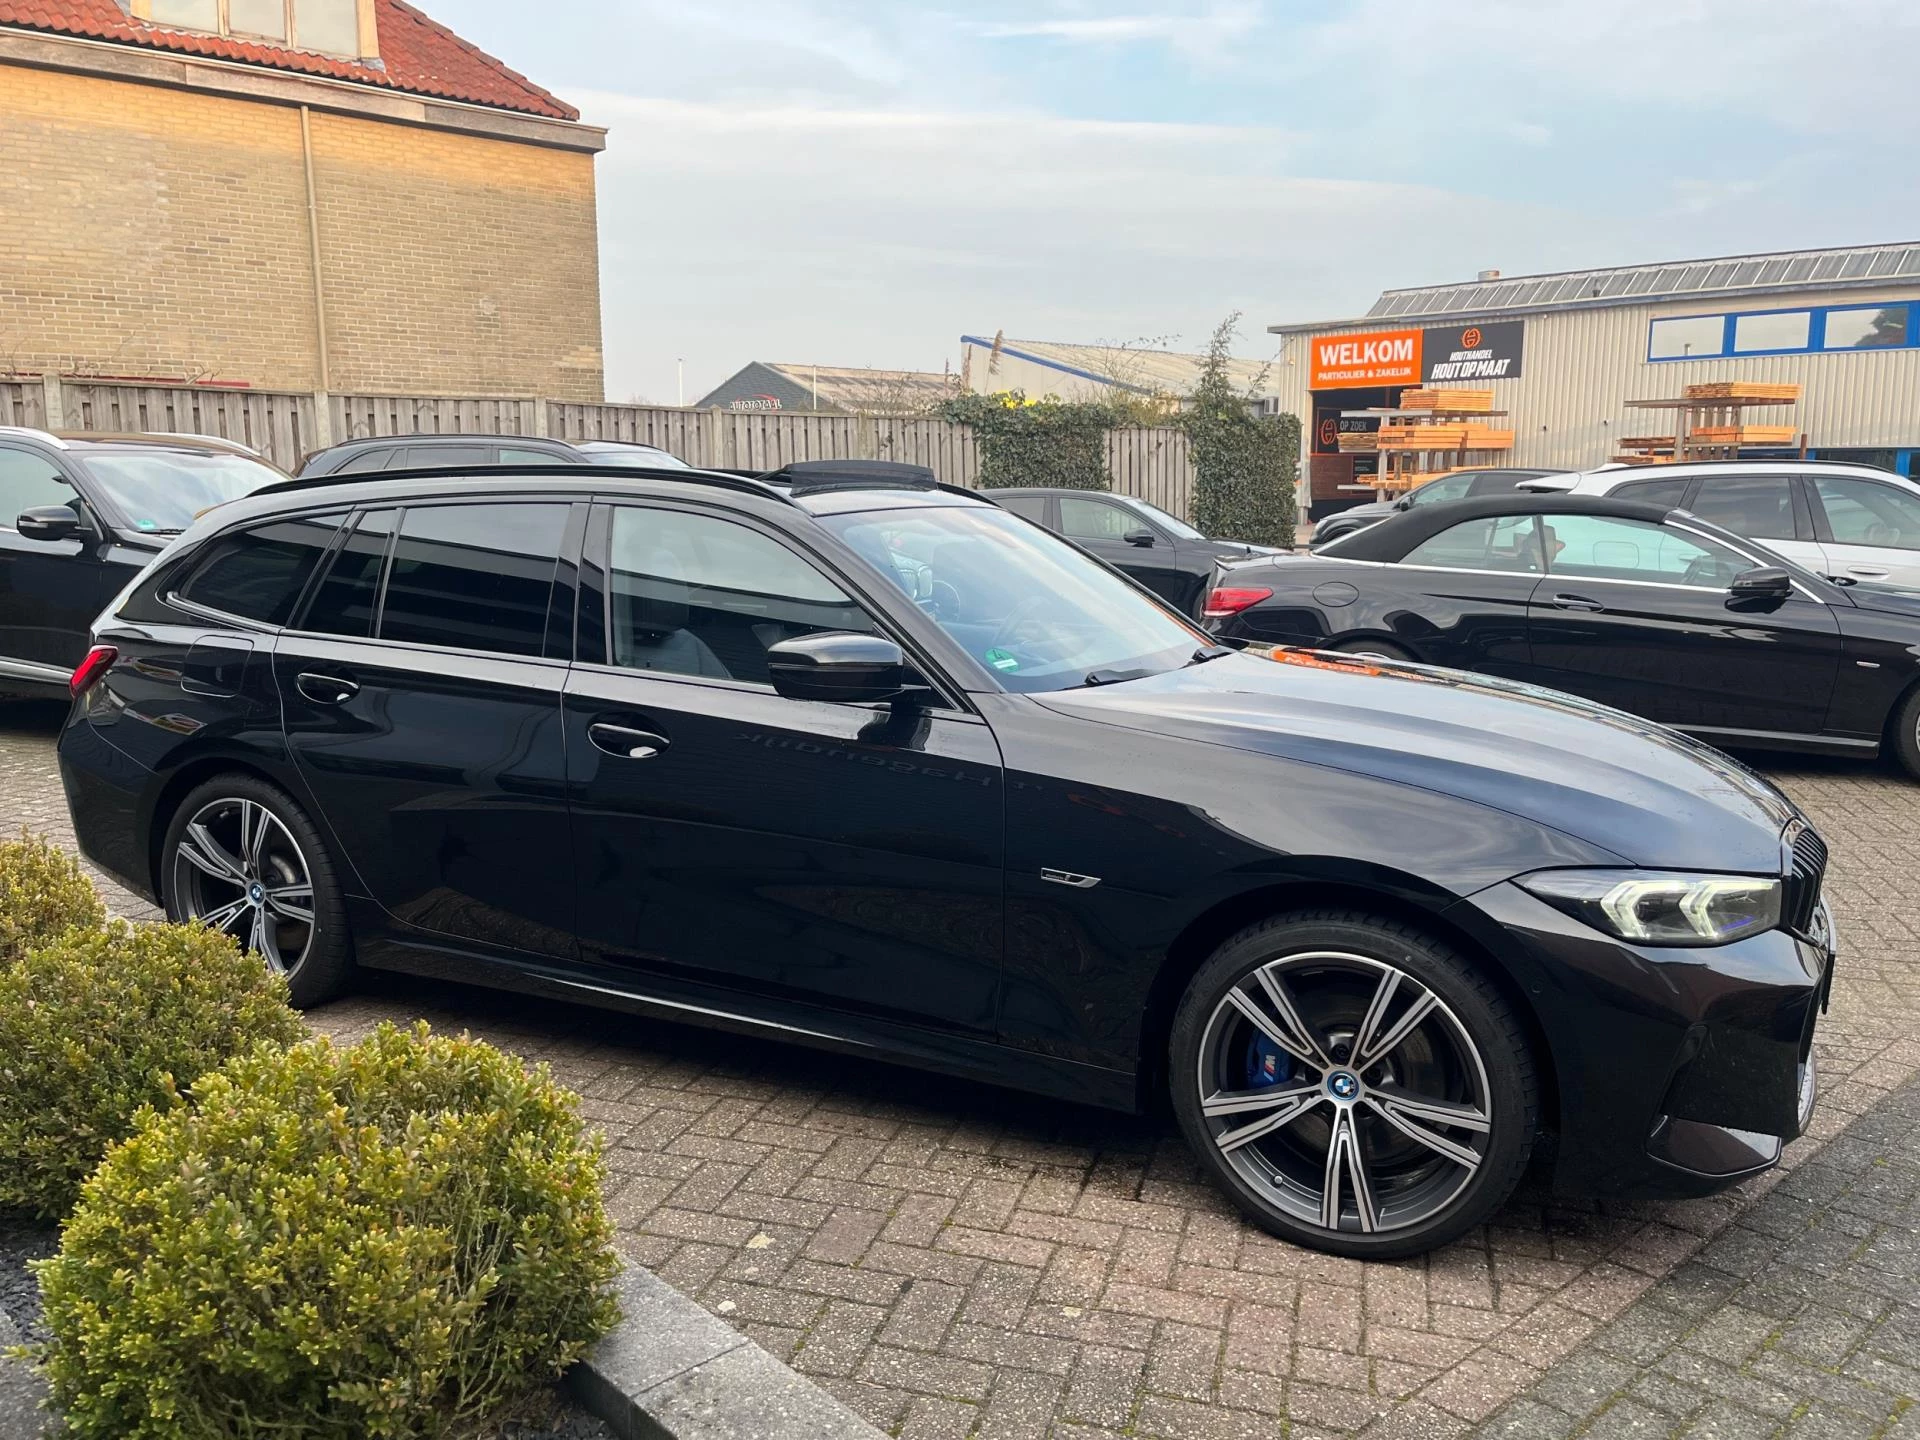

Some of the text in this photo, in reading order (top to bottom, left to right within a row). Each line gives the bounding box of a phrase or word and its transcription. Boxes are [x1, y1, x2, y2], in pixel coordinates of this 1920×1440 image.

[1319, 338, 1413, 366] WELKOM
[1449, 349, 1493, 361] HOUTHANDEL
[1318, 370, 1365, 380] PARTICULIER
[1375, 367, 1412, 378] ZAKELIJK
[730, 398, 783, 411] AUTOTOTAAL
[1340, 420, 1367, 431] OP ZOEK
